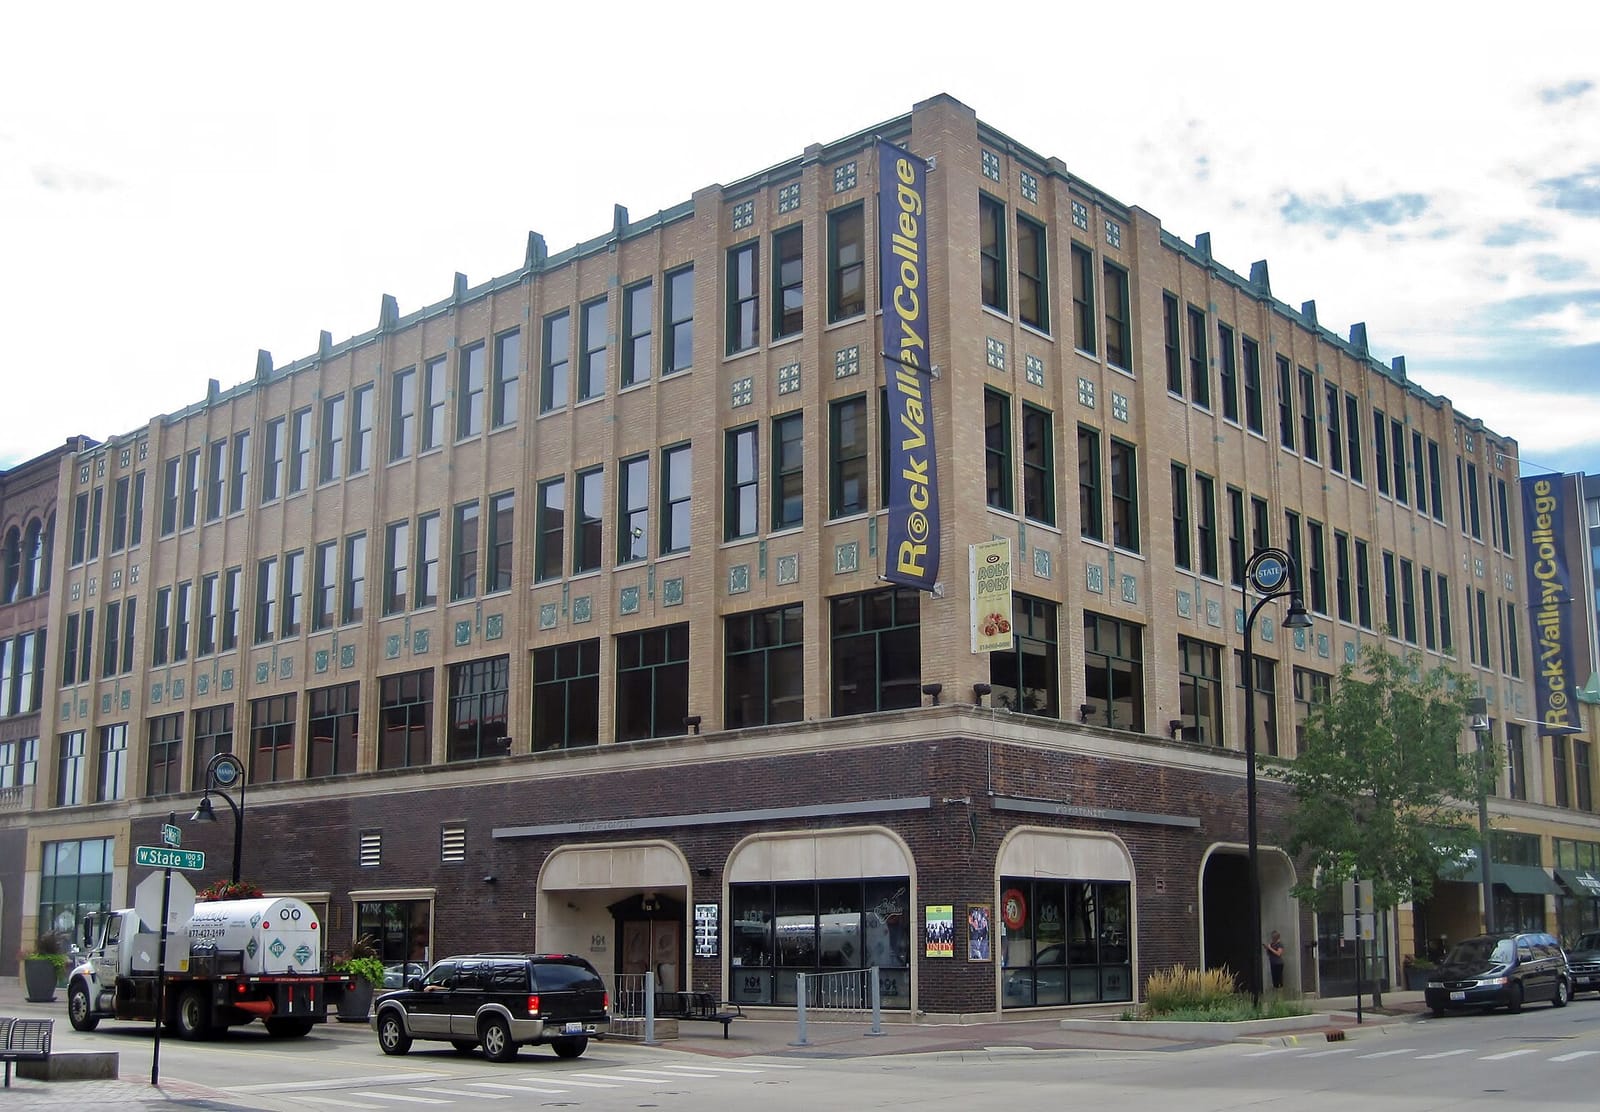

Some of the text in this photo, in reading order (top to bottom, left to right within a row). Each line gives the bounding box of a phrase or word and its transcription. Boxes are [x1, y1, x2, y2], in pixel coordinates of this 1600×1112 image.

[892, 158, 922, 321] College
[895, 320, 926, 451] Valley
[1531, 479, 1557, 580] College
[1258, 567, 1280, 577] STATE
[977, 576, 1010, 595] POLY
[140, 850, 148, 861] W
[149, 850, 181, 866] State
[185, 853, 196, 861] 100
[927, 943, 953, 951] UNITY
